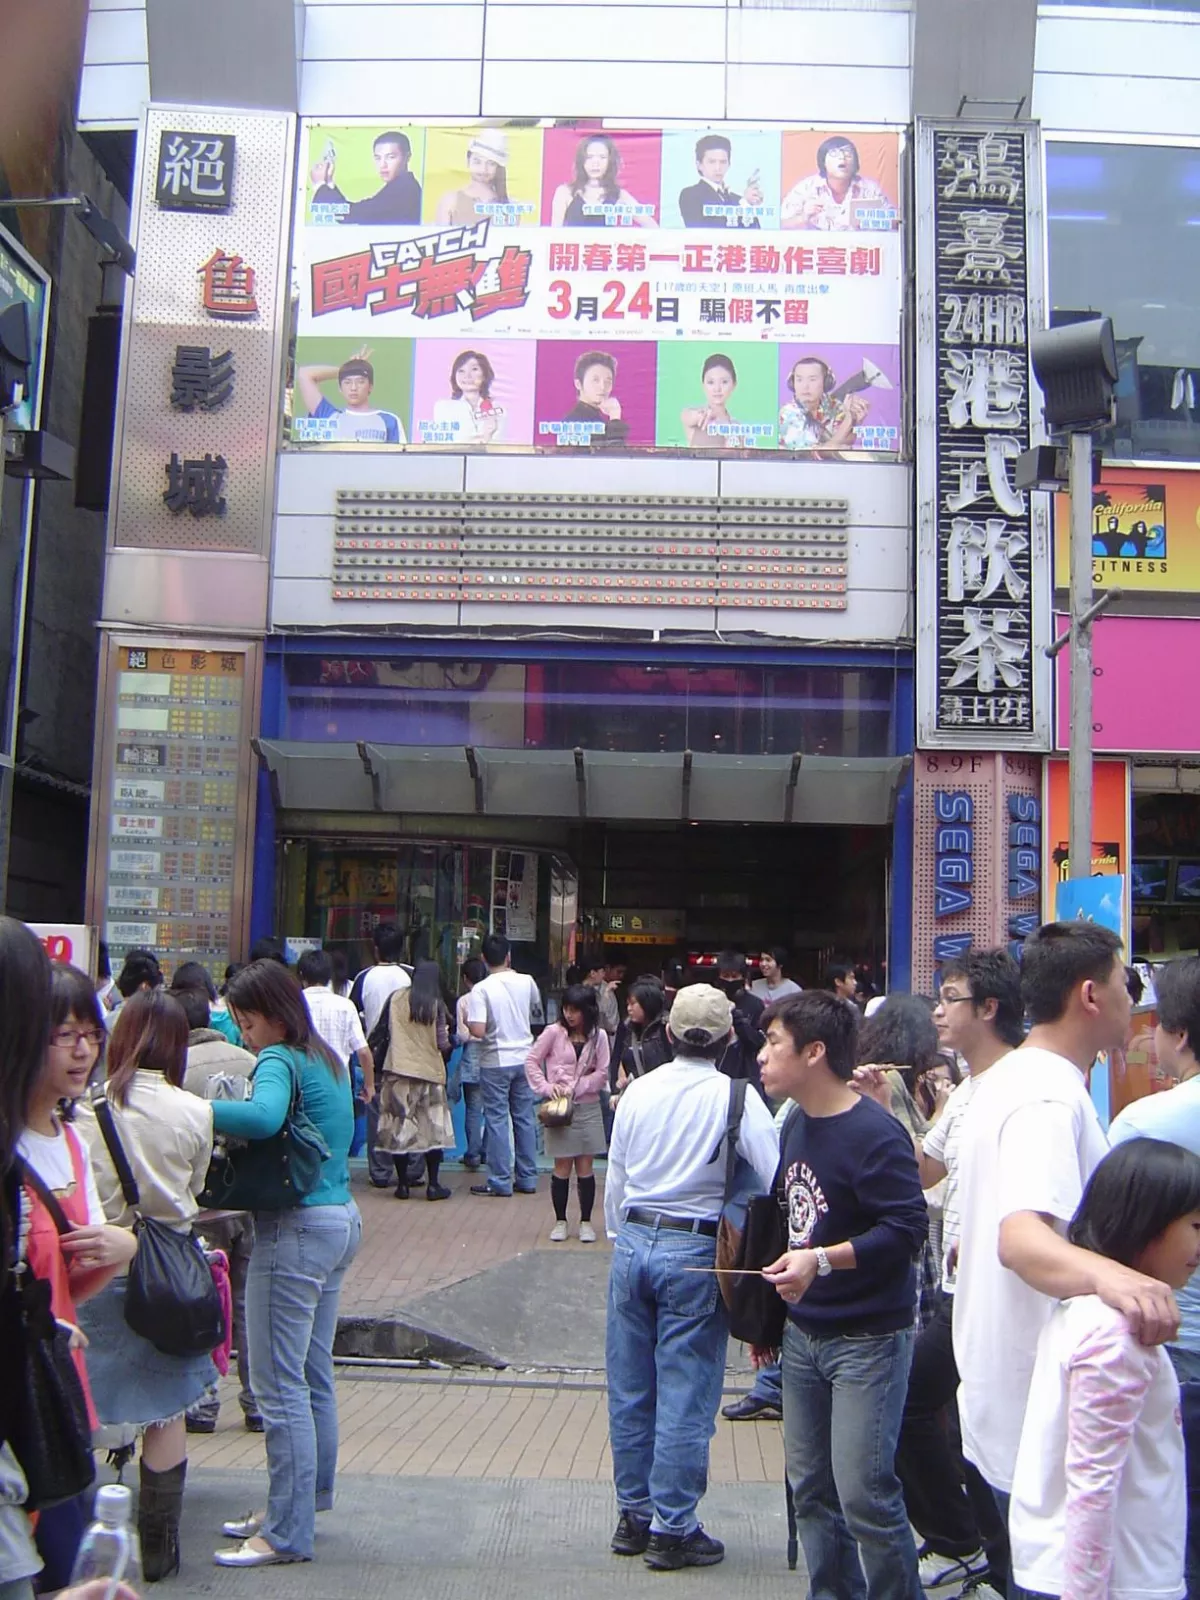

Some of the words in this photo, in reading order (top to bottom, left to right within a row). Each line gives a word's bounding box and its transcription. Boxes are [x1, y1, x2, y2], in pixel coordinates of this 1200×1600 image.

[369, 218, 490, 269] CATCH
[549, 243, 881, 275] 開春第一正港動作喜劇
[311, 246, 532, 321] 國士無雙
[547, 280, 679, 323] 3月24日
[699, 298, 809, 324] 騙假不留
[161, 135, 258, 517] 絕色影城
[1092, 500, 1163, 516] California
[129, 651, 237, 672] 絕色影城
[934, 790, 974, 919] SEGA
